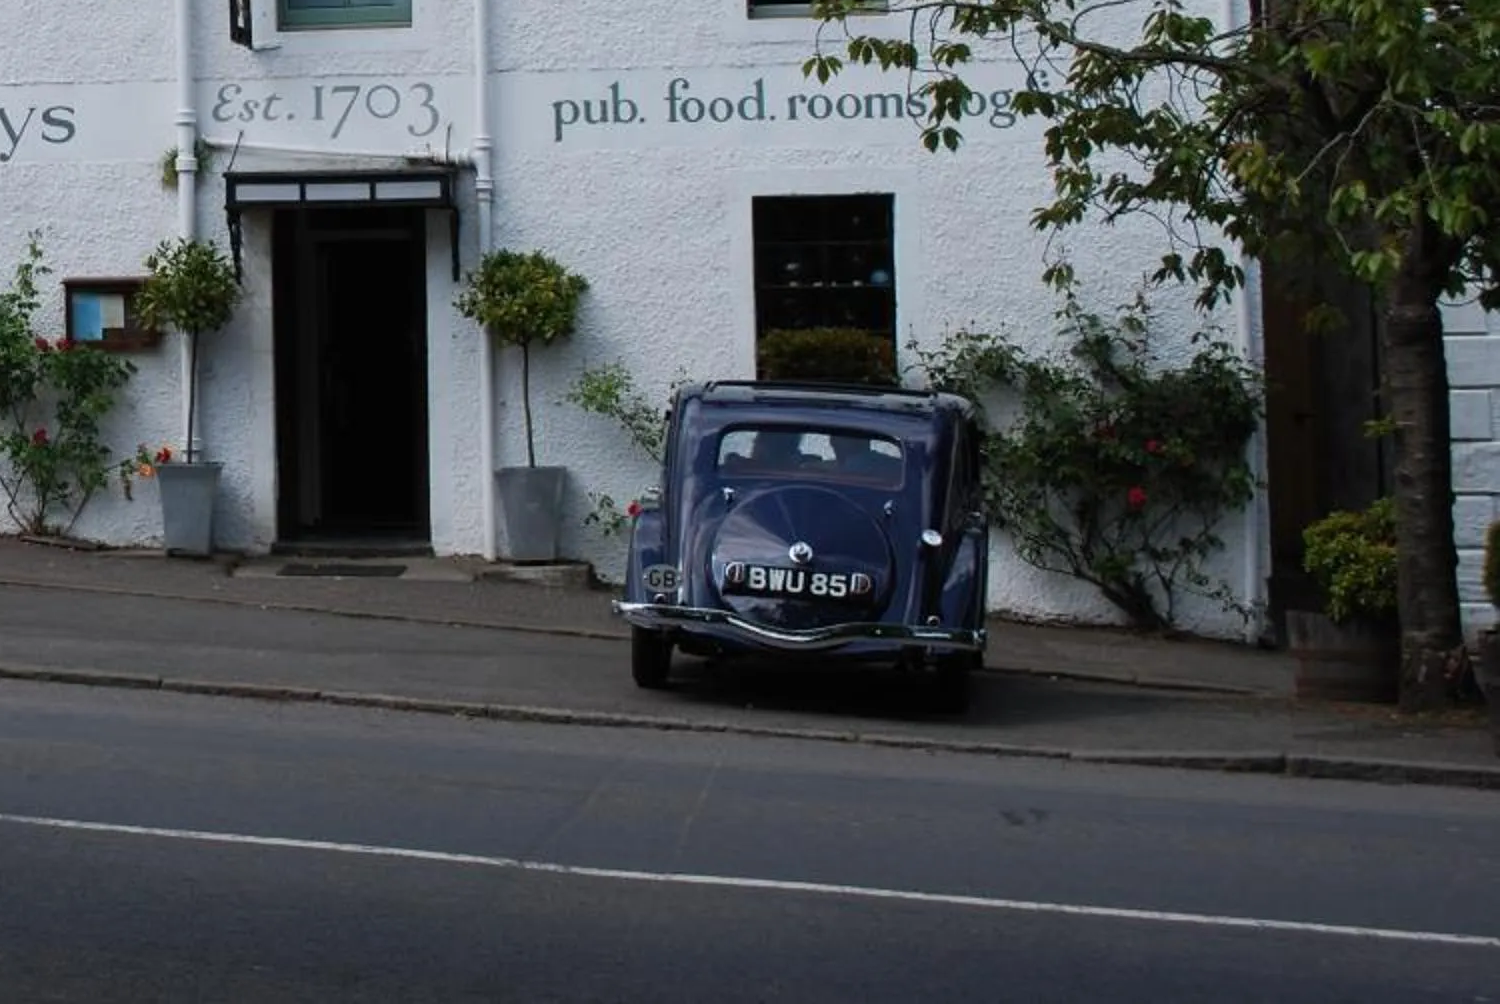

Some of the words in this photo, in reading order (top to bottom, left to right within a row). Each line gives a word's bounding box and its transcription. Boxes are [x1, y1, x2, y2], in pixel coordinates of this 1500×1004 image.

[211, 83, 296, 123] Est.
[312, 81, 440, 140] 1703
[552, 80, 646, 143] pub.
[663, 77, 776, 124] food.
[956, 80, 1017, 129] og
[649, 569, 678, 588] GB
[748, 567, 804, 593] BWU
